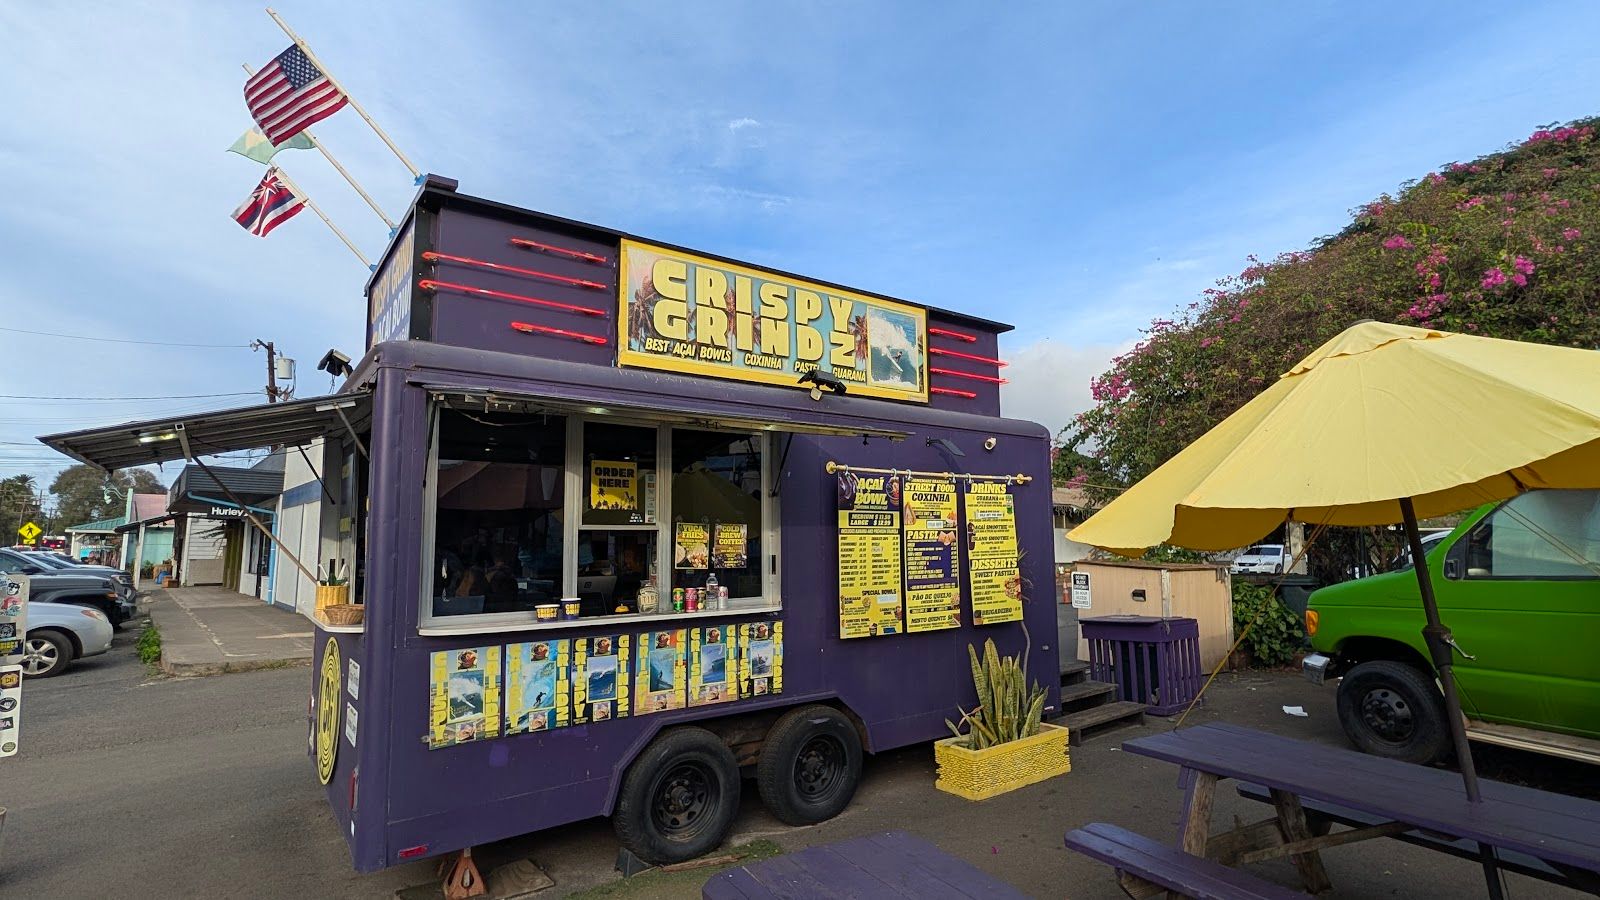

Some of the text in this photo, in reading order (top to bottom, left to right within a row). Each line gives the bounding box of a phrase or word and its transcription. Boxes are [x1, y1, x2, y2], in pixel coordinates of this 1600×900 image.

[652, 259, 854, 332] CRISPY
[652, 298, 857, 368] GRINDZ
[645, 337, 671, 353] BEST
[673, 342, 696, 358] AÇAI
[700, 346, 732, 362] BOWLS
[744, 353, 782, 370] COXINHA
[594, 467, 635, 478] ORDER
[598, 478, 630, 488] HERE
[904, 482, 956, 493] STREET FOOD
[970, 483, 1007, 494] DRINKS
[853, 493, 888, 505] BOWL
[911, 492, 950, 502] COXINHA
[211, 506, 245, 517] Hurley
[683, 524, 703, 532] YUCA
[682, 531, 704, 539] FRIES
[907, 530, 939, 540] PASTEL
[971, 558, 1018, 570] DESSERTS
[641, 595, 657, 604] TIPS
[739, 624, 750, 694] CRISPY
[773, 621, 783, 689] GRINDZ
[573, 638, 587, 718] CRISPY
[617, 634, 630, 712] GRINDZ
